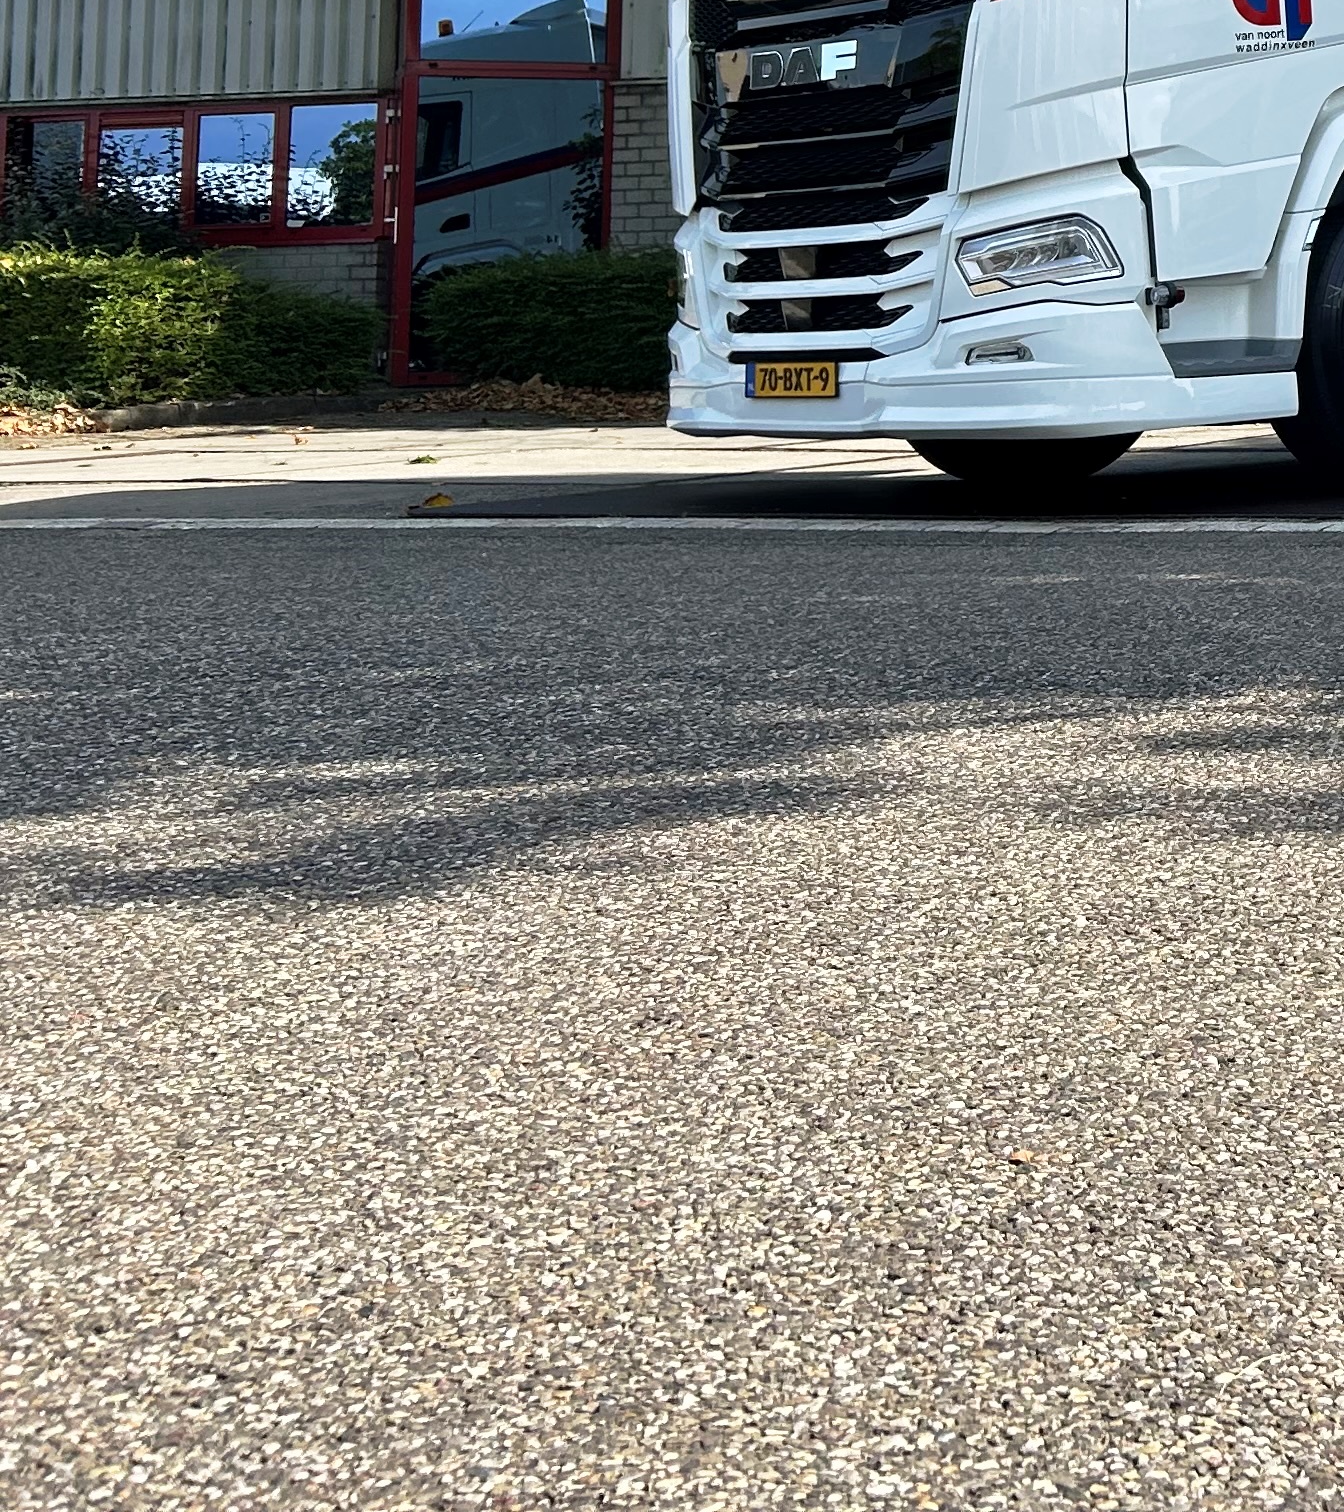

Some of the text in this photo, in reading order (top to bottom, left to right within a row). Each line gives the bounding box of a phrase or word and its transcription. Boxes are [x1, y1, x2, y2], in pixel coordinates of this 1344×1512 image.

[1234, 29, 1285, 41] van noort
[749, 39, 858, 90] DAF
[758, 366, 830, 392] 70-BXT-9
